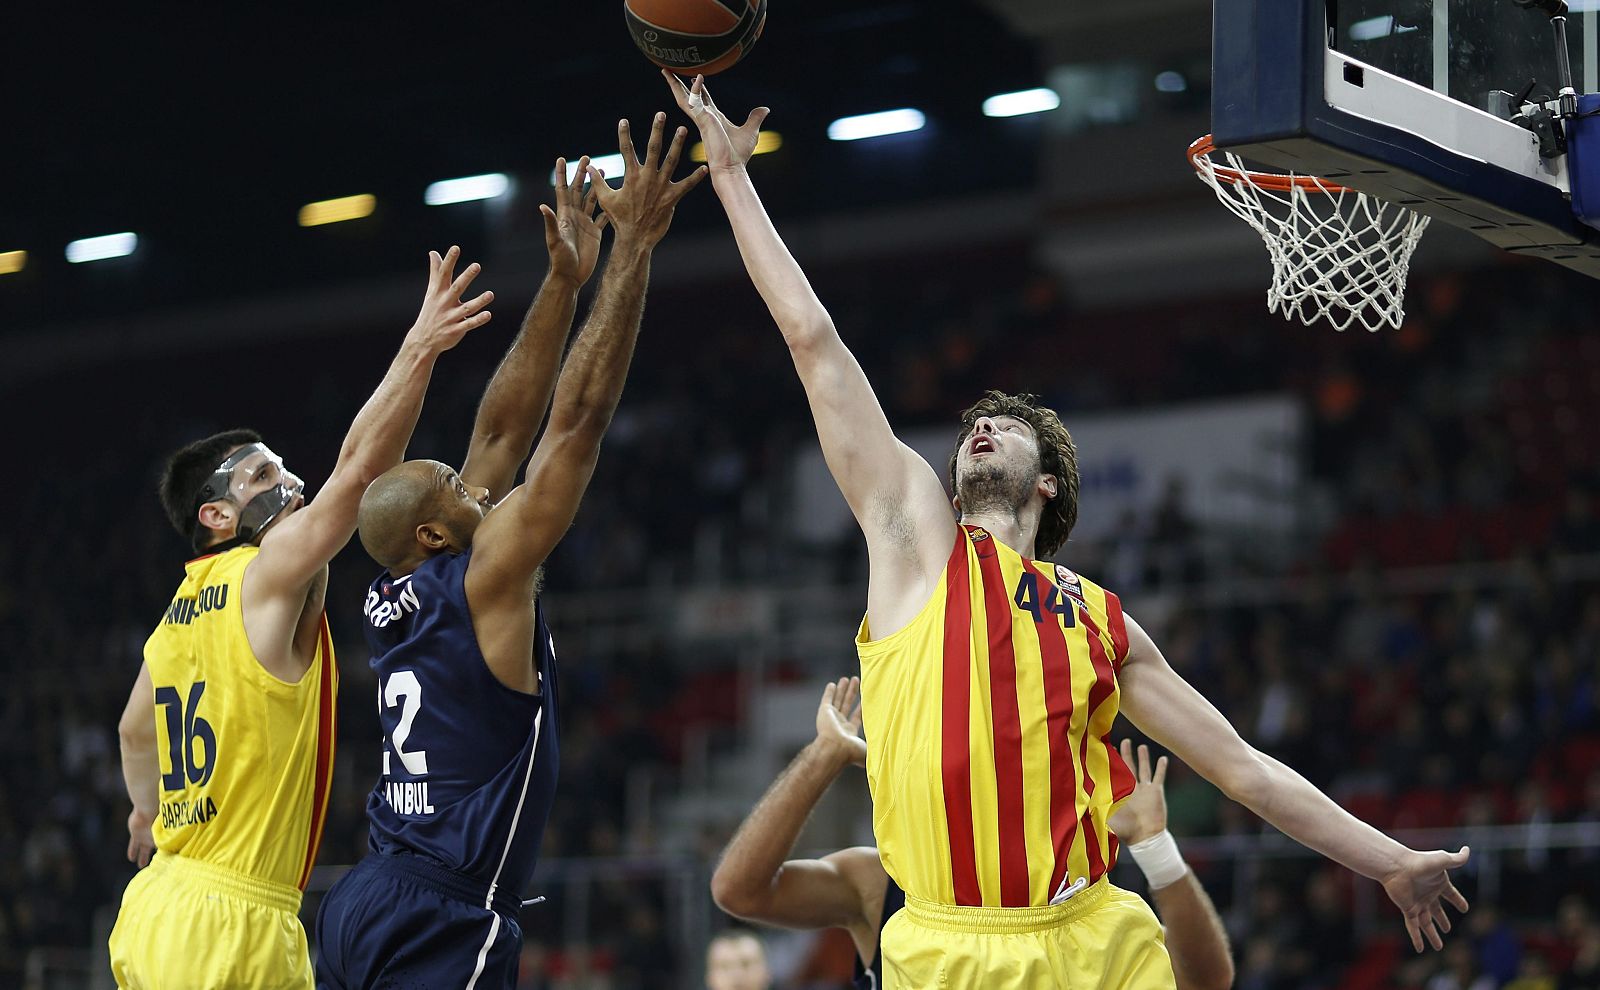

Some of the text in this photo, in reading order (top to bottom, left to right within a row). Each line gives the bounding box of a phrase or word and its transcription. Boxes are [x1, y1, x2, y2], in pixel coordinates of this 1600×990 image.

[1013, 571, 1076, 629] 44
[155, 680, 217, 791] 16
[377, 670, 429, 775] 2
